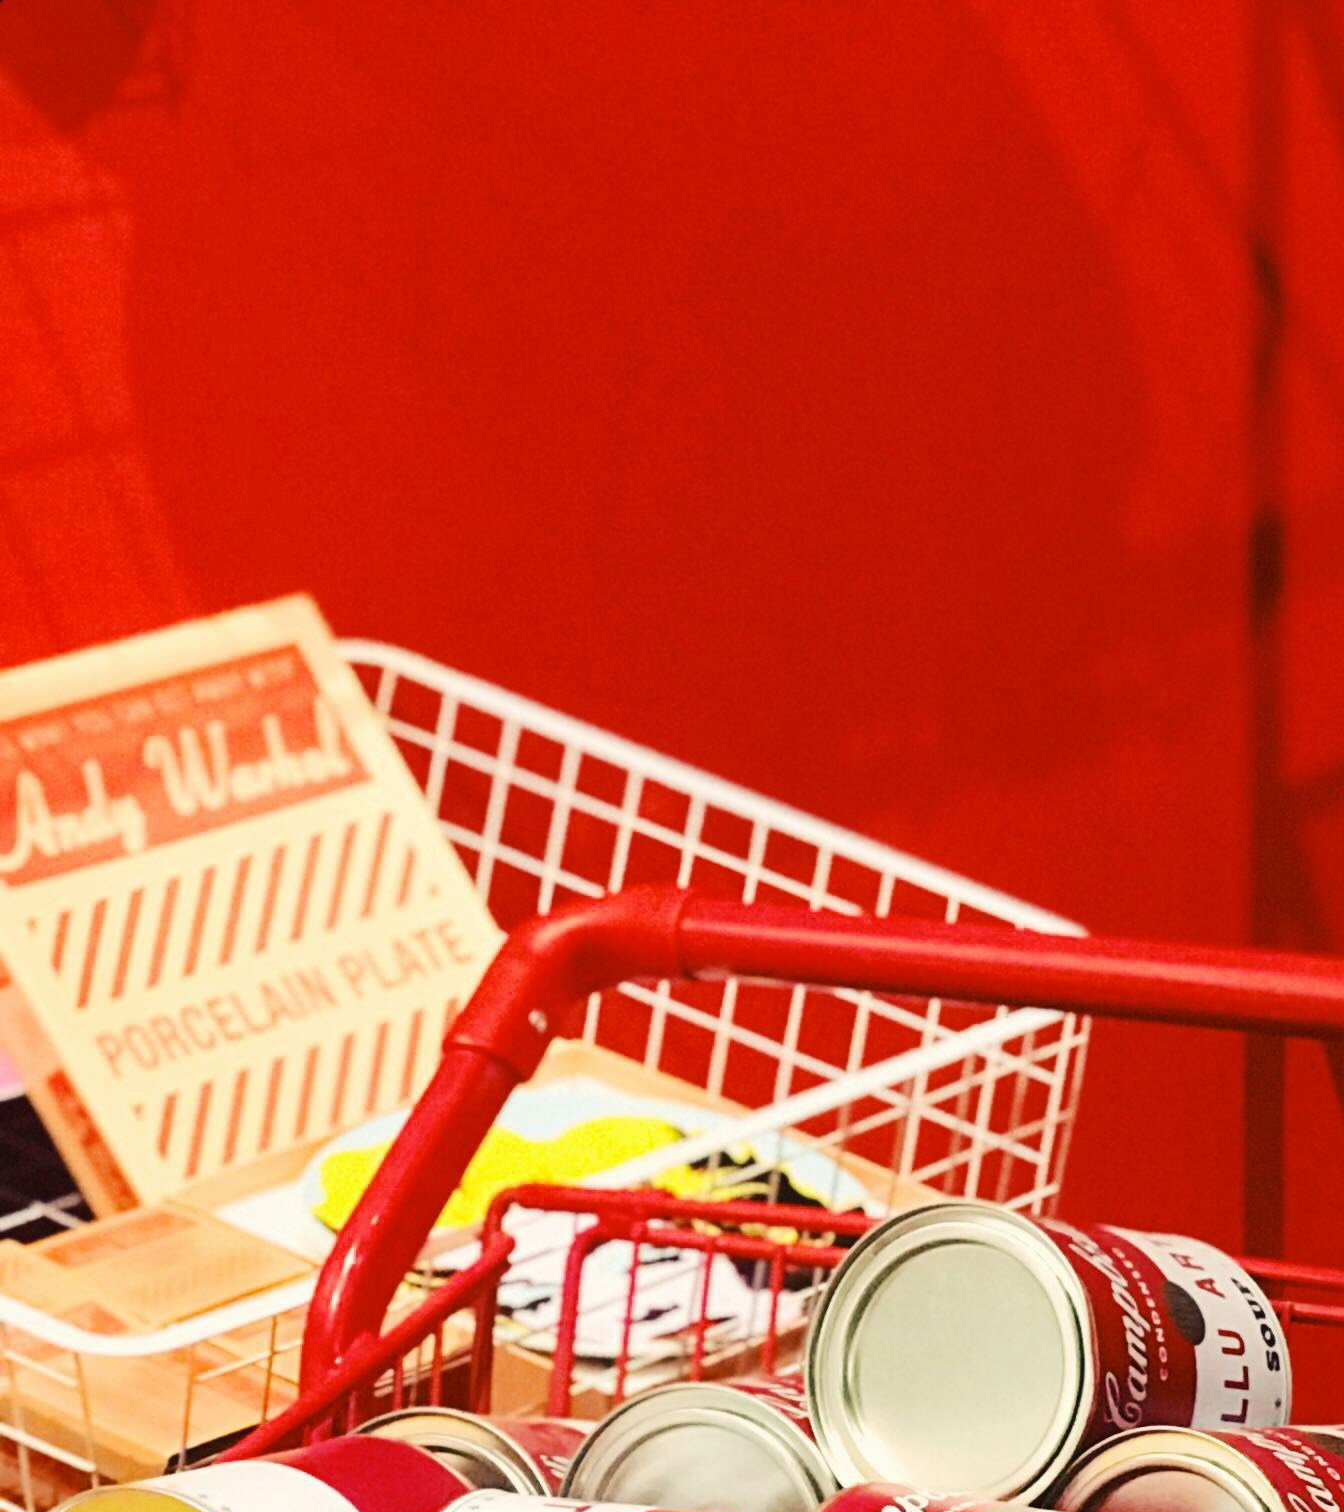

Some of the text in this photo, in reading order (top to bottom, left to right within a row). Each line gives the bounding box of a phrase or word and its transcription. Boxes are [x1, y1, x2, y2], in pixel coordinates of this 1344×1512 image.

[96, 920, 472, 1079] PORCELAIN PLATE
[1219, 1328, 1250, 1424] LLU
